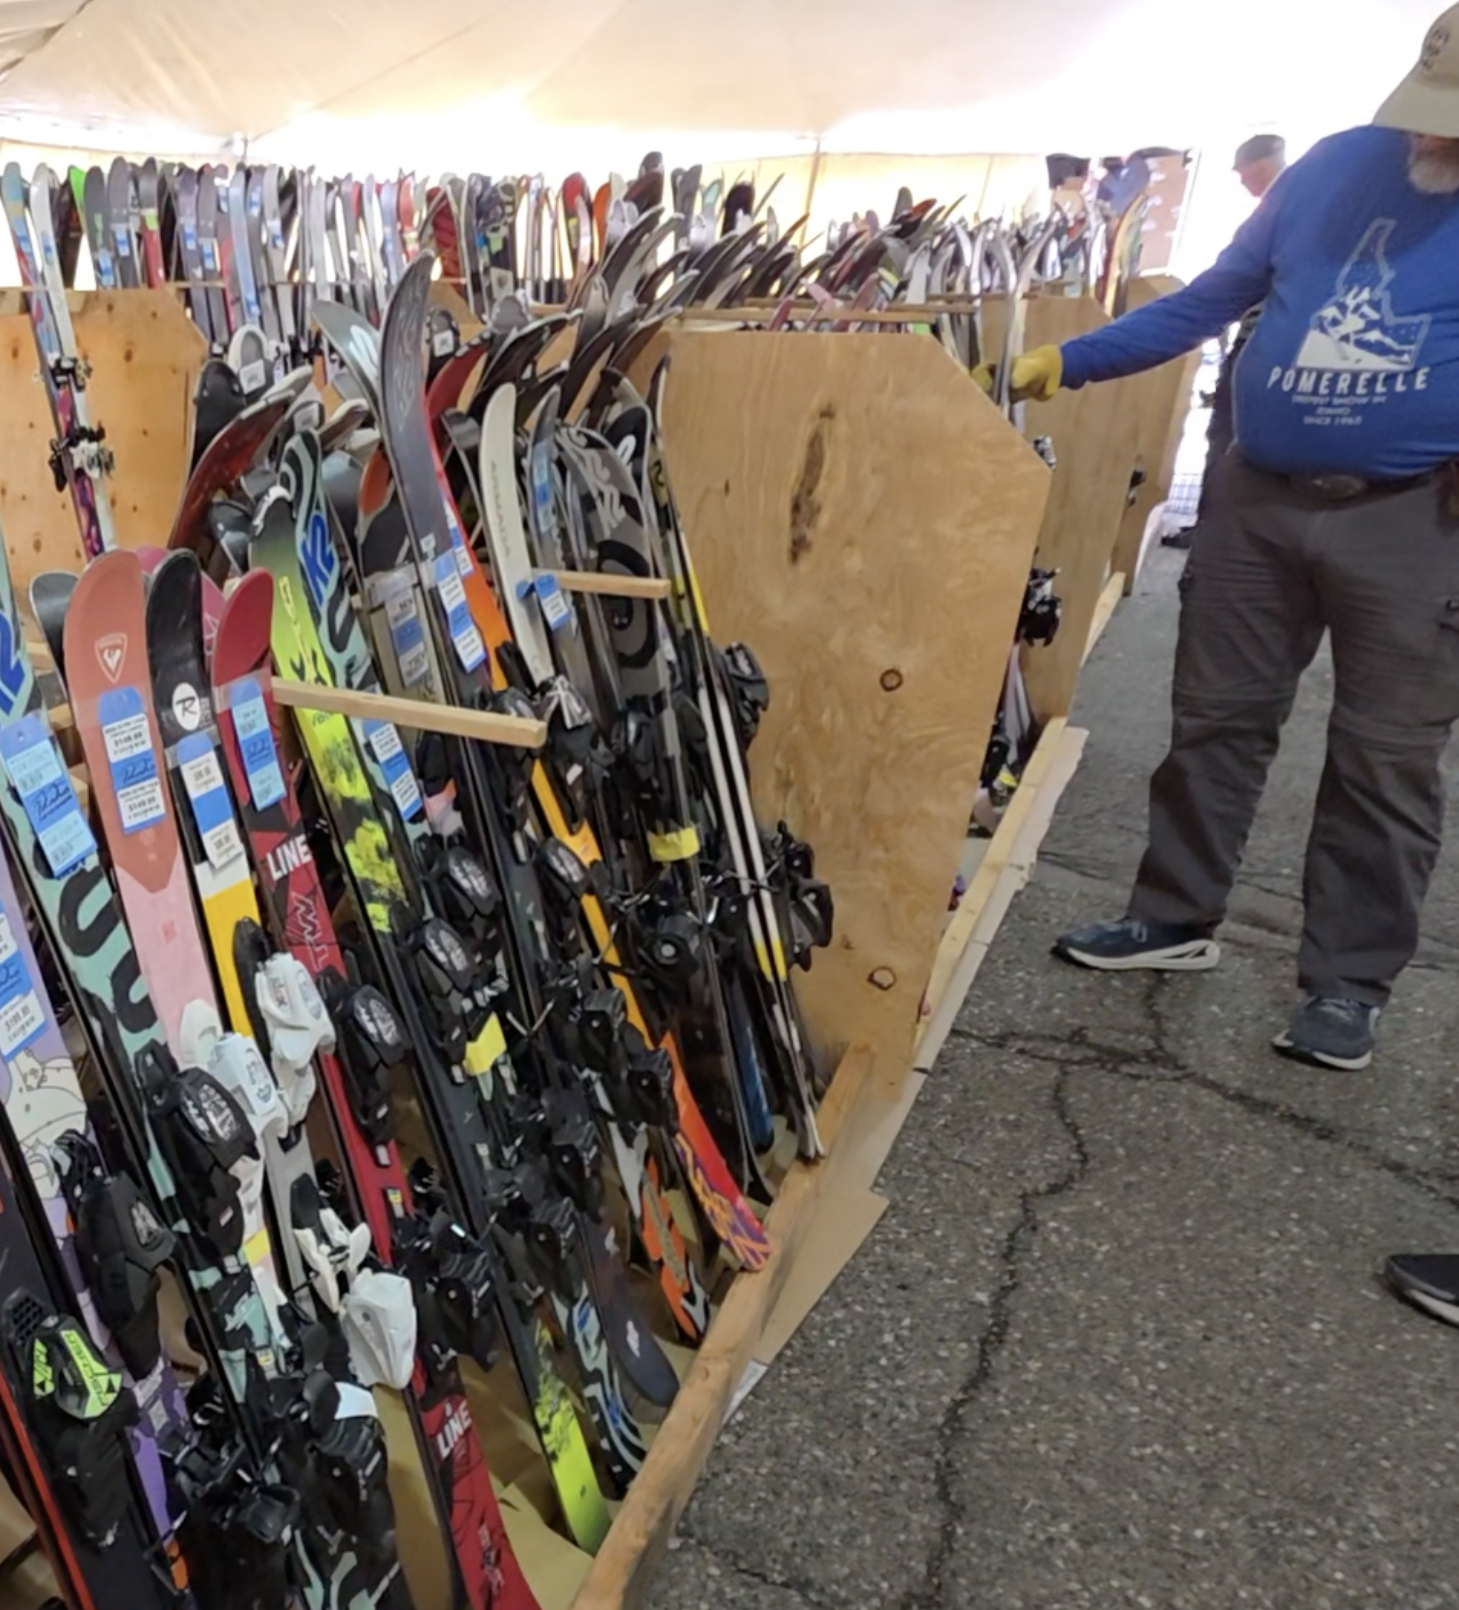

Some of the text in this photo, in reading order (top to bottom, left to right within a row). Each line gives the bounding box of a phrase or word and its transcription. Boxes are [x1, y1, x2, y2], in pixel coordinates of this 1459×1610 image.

[1266, 365, 1431, 395] POMERELLE
[265, 832, 313, 882] LINE
[436, 1398, 473, 1461] LINE
